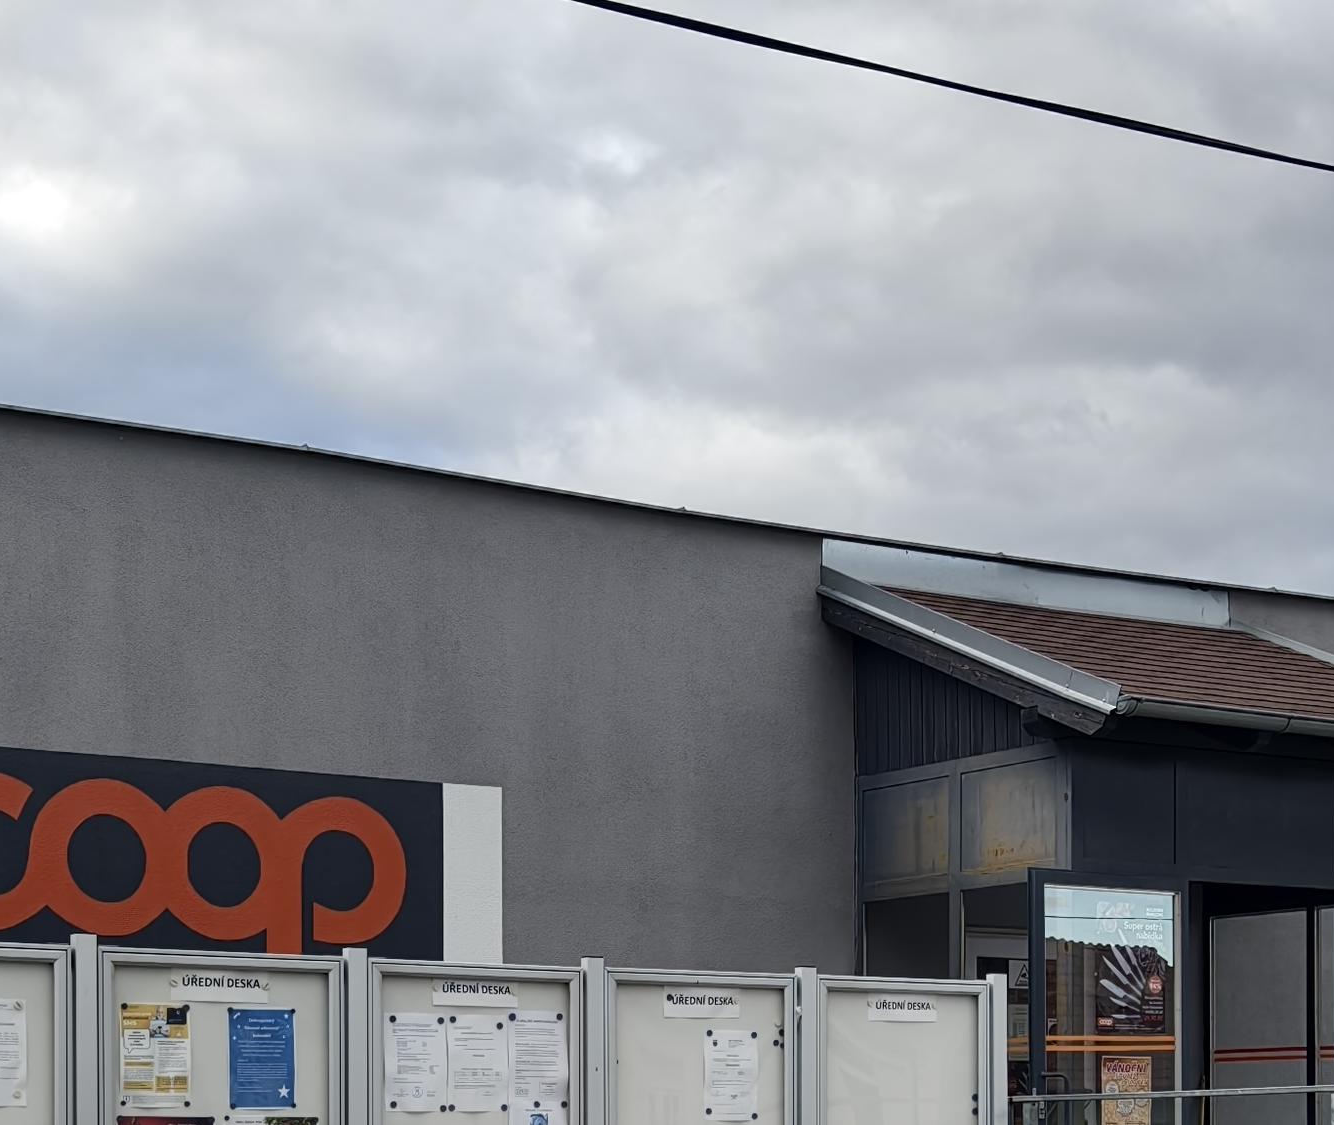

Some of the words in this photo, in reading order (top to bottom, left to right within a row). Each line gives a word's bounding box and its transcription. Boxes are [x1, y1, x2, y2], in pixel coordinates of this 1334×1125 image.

[182, 974, 225, 988] ÚŘEDNÍ
[227, 978, 261, 989] DESKA
[442, 981, 479, 994] ÚŘEDNÍ
[481, 984, 510, 995] DESKA
[672, 993, 706, 1005] ÚŘEDNÍ
[707, 996, 734, 1006] DESKA
[907, 1002, 932, 1011] DESKA
